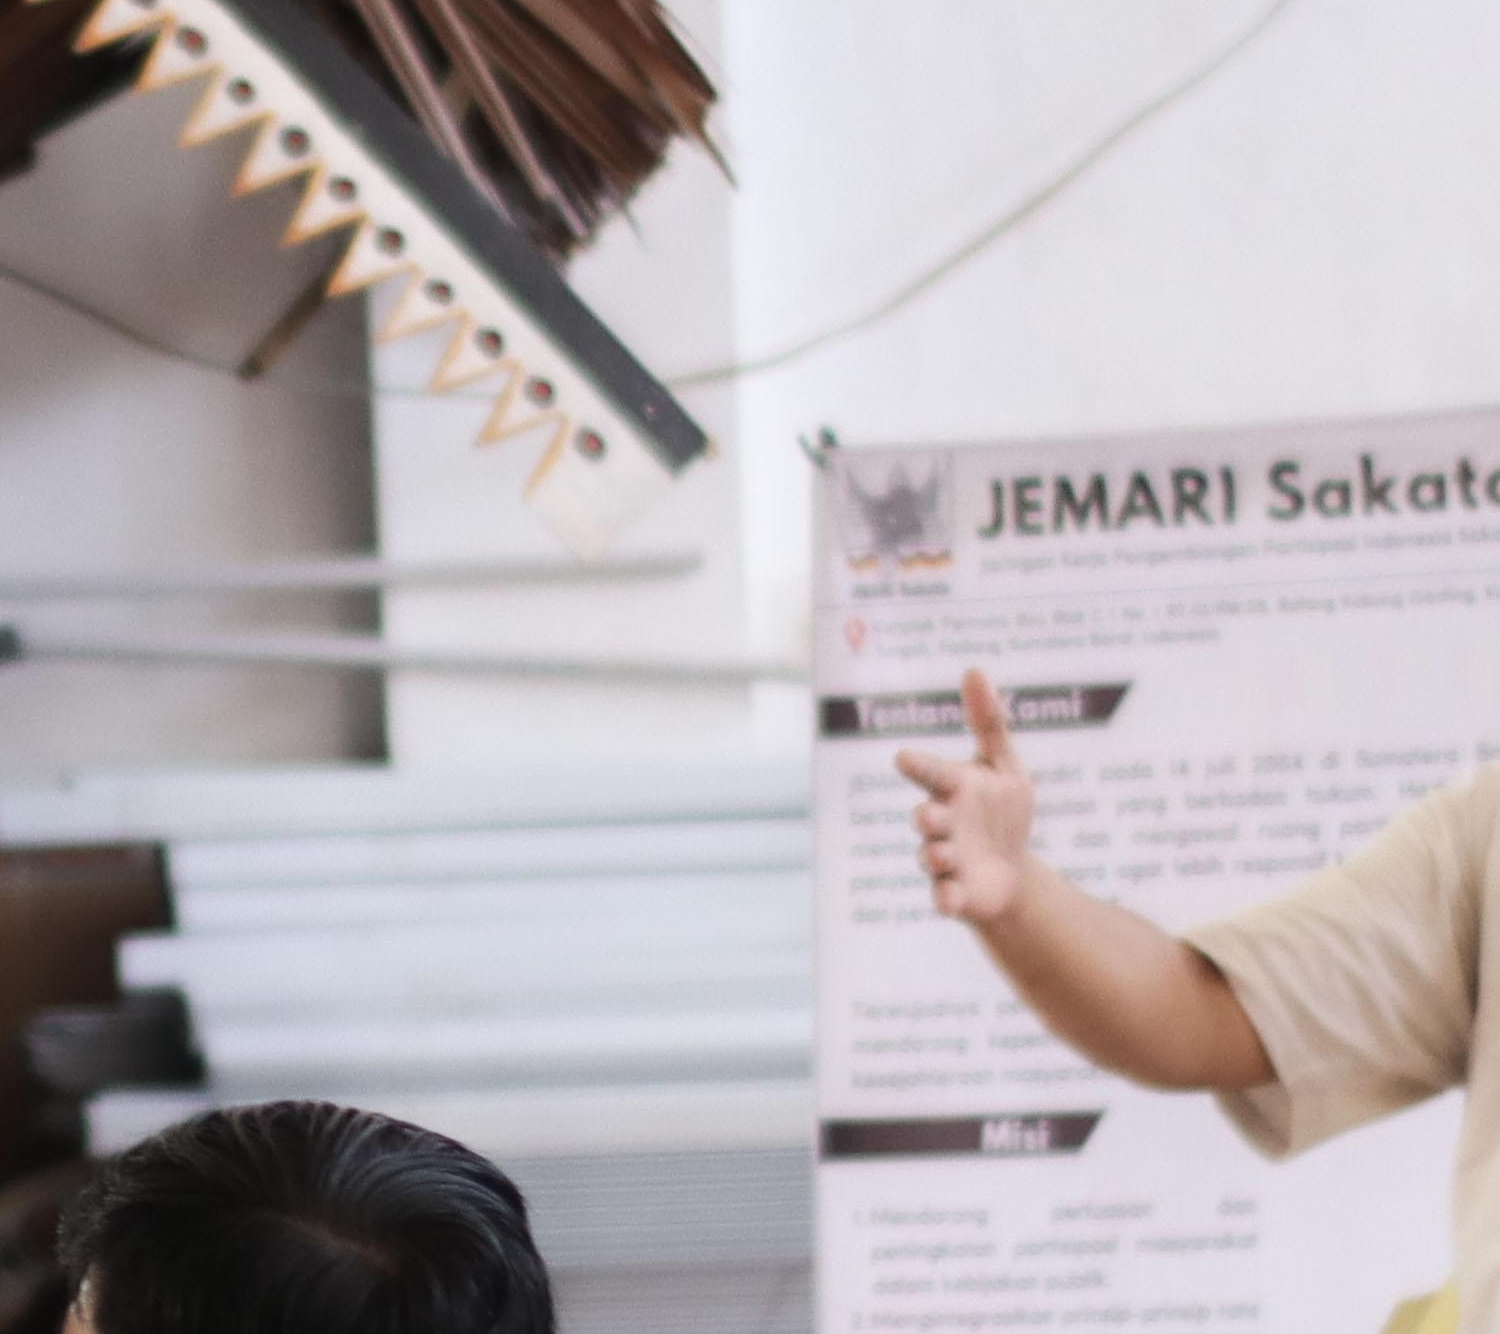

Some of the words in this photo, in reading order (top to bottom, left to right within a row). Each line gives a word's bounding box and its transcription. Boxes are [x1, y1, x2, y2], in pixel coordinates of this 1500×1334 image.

[976, 463, 1239, 541] JEMARI
[860, 696, 964, 730] Tentan
[1355, 743, 1460, 770] Sumatera
[1116, 796, 1169, 819] yang
[981, 1117, 1053, 1153] Misi
[868, 1206, 990, 1229] Mendorong
[1137, 1232, 1258, 1253] masyarakat
